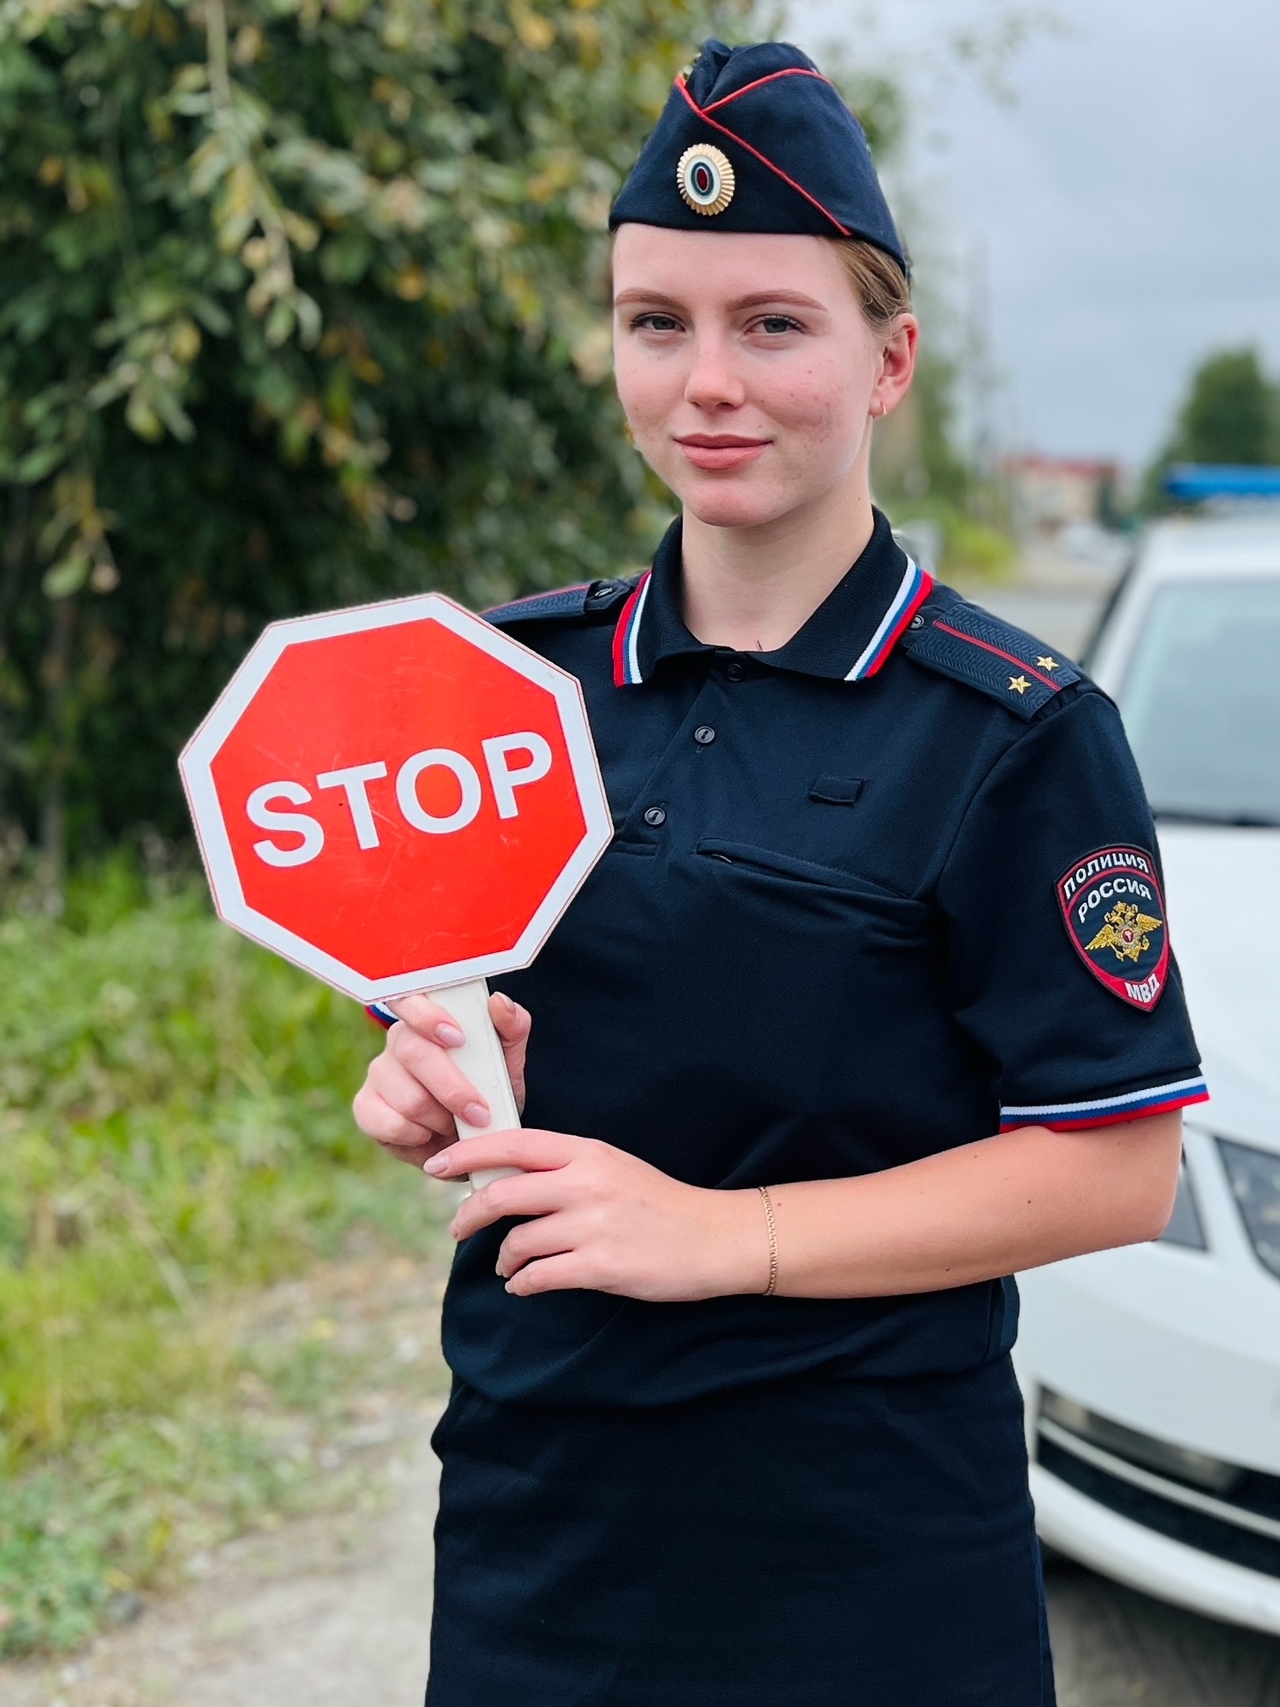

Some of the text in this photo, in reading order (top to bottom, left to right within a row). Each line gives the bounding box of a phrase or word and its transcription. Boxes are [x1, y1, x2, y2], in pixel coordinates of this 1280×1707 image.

[246, 731, 553, 867] STOP
[1063, 853, 1149, 900] ПОЛИЦИЯ
[1077, 878, 1152, 924] РОССИЯ
[1124, 973, 1160, 1003] МВД
